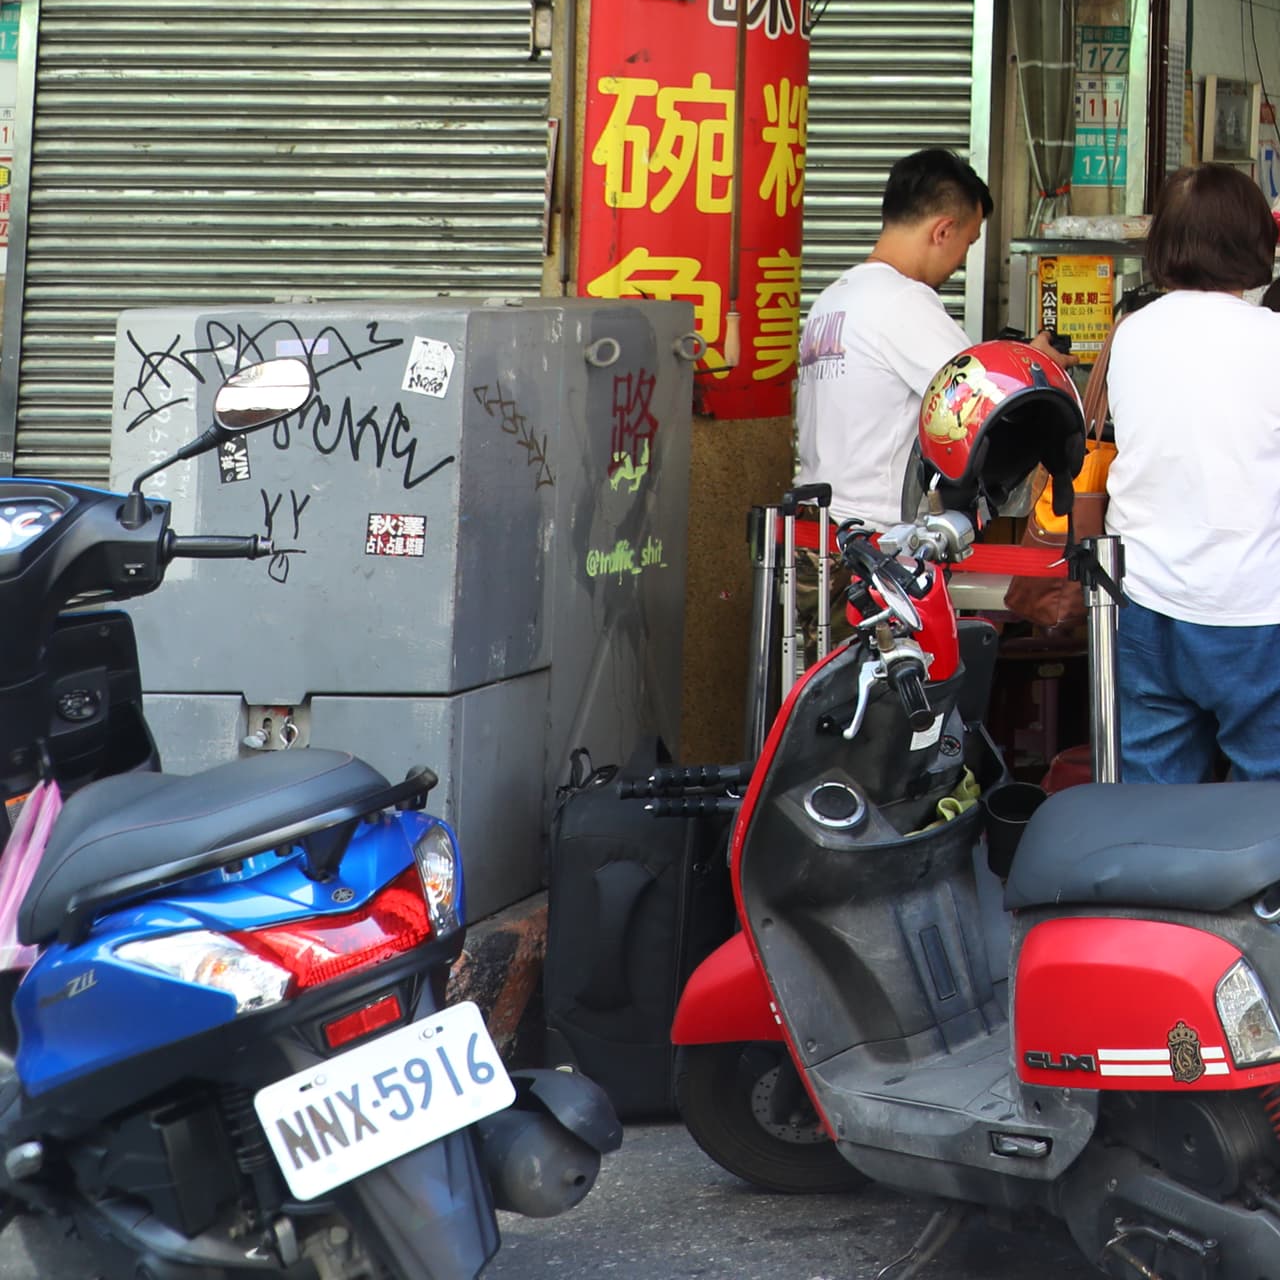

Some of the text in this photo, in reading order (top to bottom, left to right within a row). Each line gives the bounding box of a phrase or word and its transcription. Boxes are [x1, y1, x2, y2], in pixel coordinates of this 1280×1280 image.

[1087, 46, 1129, 70] 177
[1081, 154, 1121, 176] 177
[1042, 291, 1057, 325] 公告
[1061, 291, 1112, 305] 每星期二
[369, 516, 424, 536] 秋澤
[275, 1030, 498, 1171] NNX-5916
